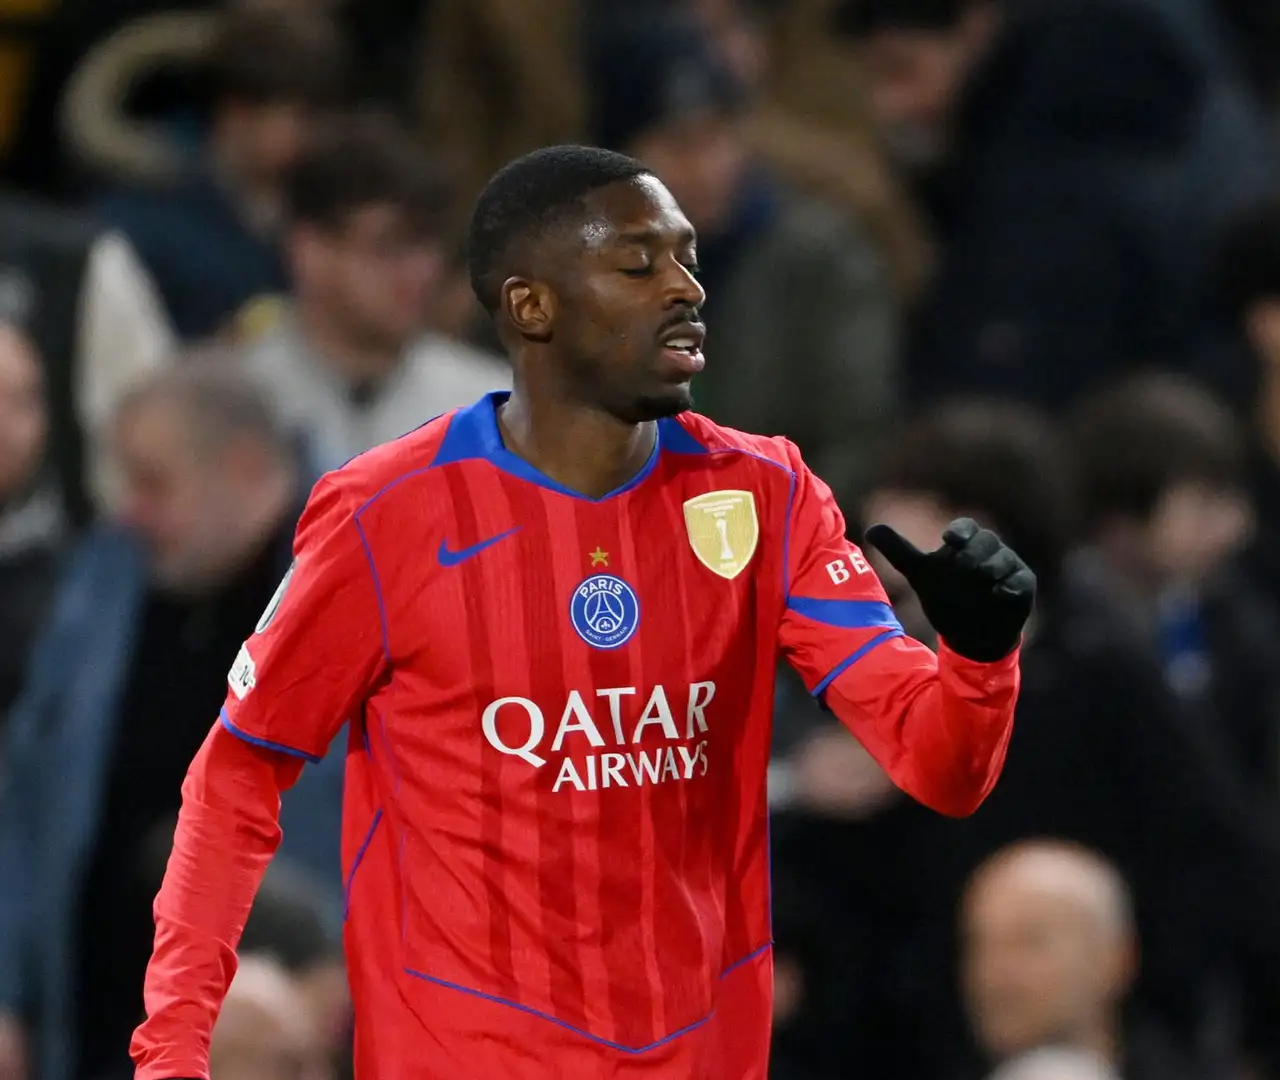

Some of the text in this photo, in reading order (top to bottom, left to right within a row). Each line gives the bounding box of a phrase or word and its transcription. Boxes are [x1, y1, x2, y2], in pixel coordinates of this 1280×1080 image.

[579, 579, 624, 599] PARIS
[481, 681, 716, 769] QATAR
[551, 740, 708, 793] AIRWAYS
